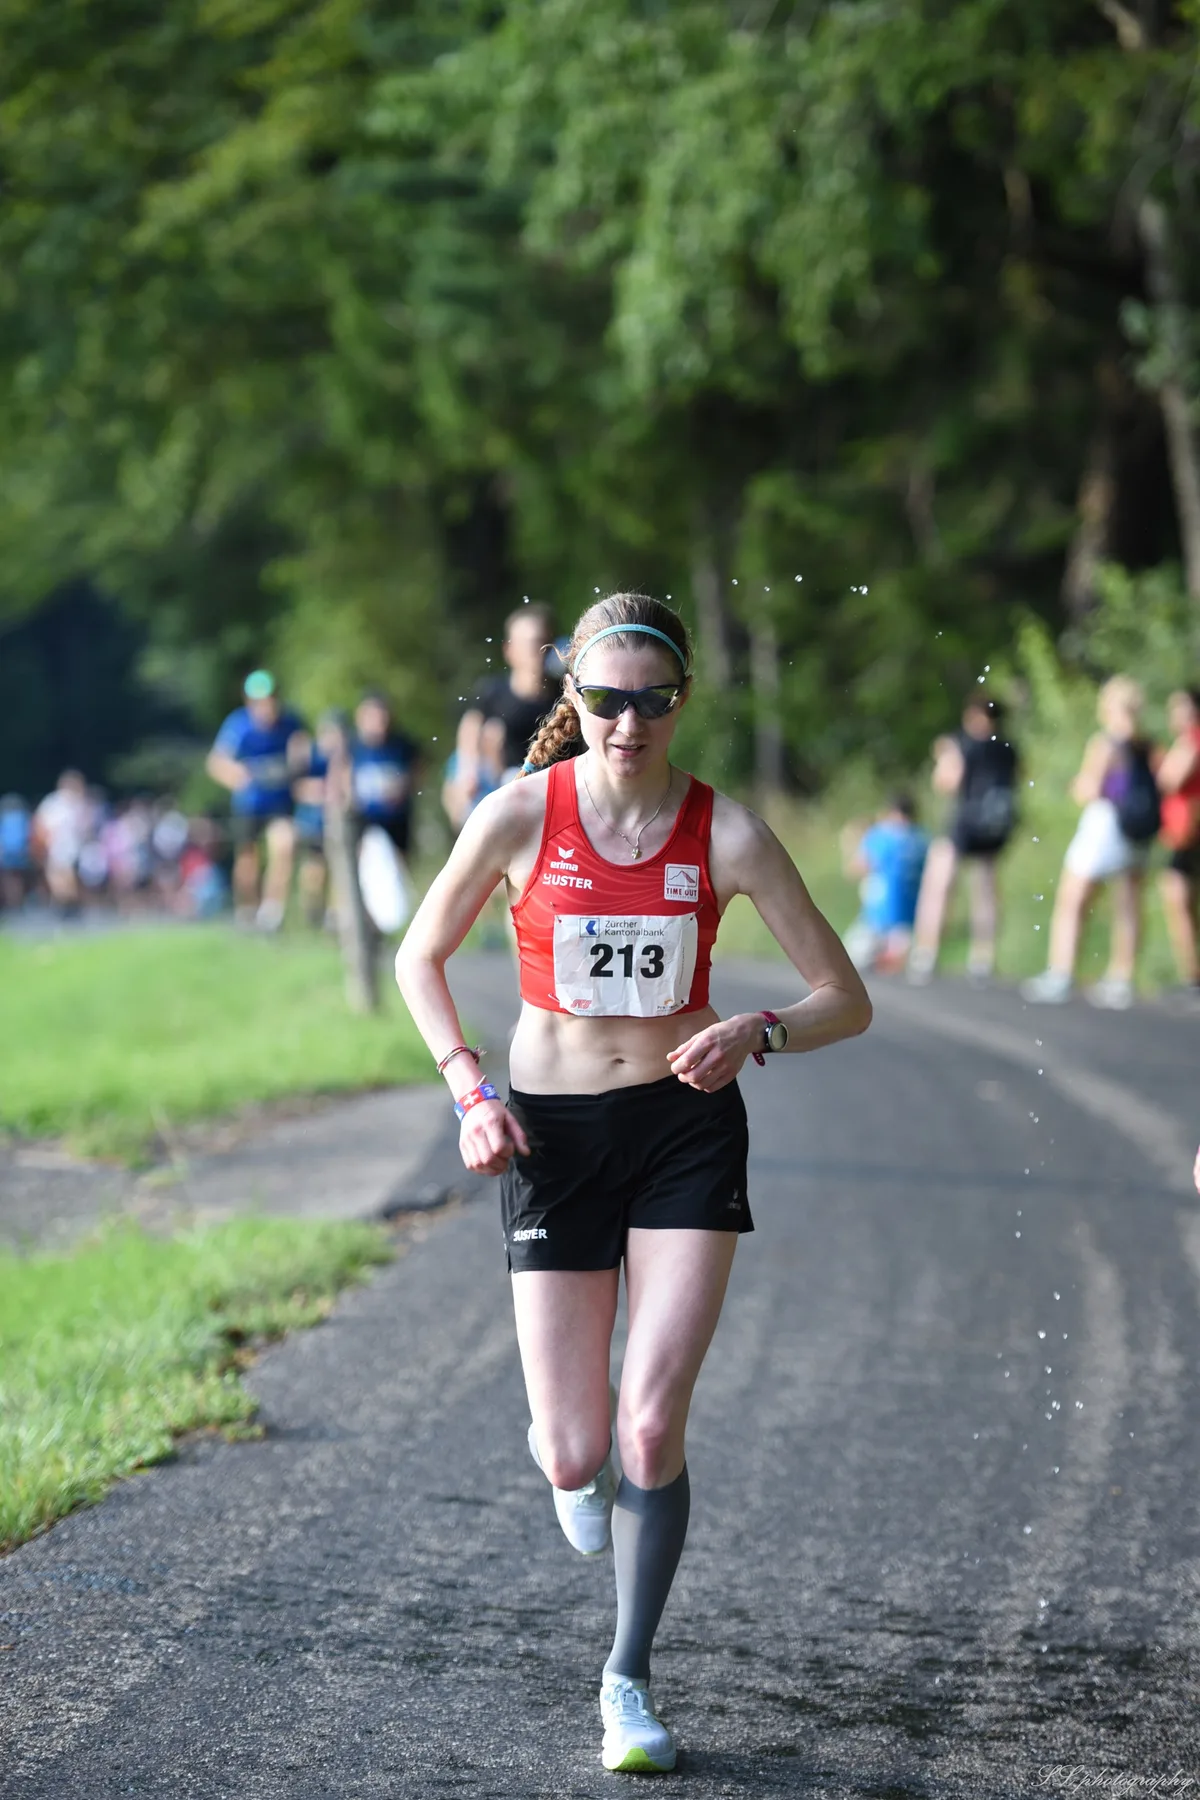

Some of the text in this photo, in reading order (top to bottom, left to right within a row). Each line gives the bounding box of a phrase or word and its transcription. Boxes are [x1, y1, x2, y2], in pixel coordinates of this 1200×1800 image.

[550, 860, 578, 872] erima
[552, 874, 593, 890] USTER
[605, 920, 637, 928] Zürcher
[589, 943, 664, 978] 213
